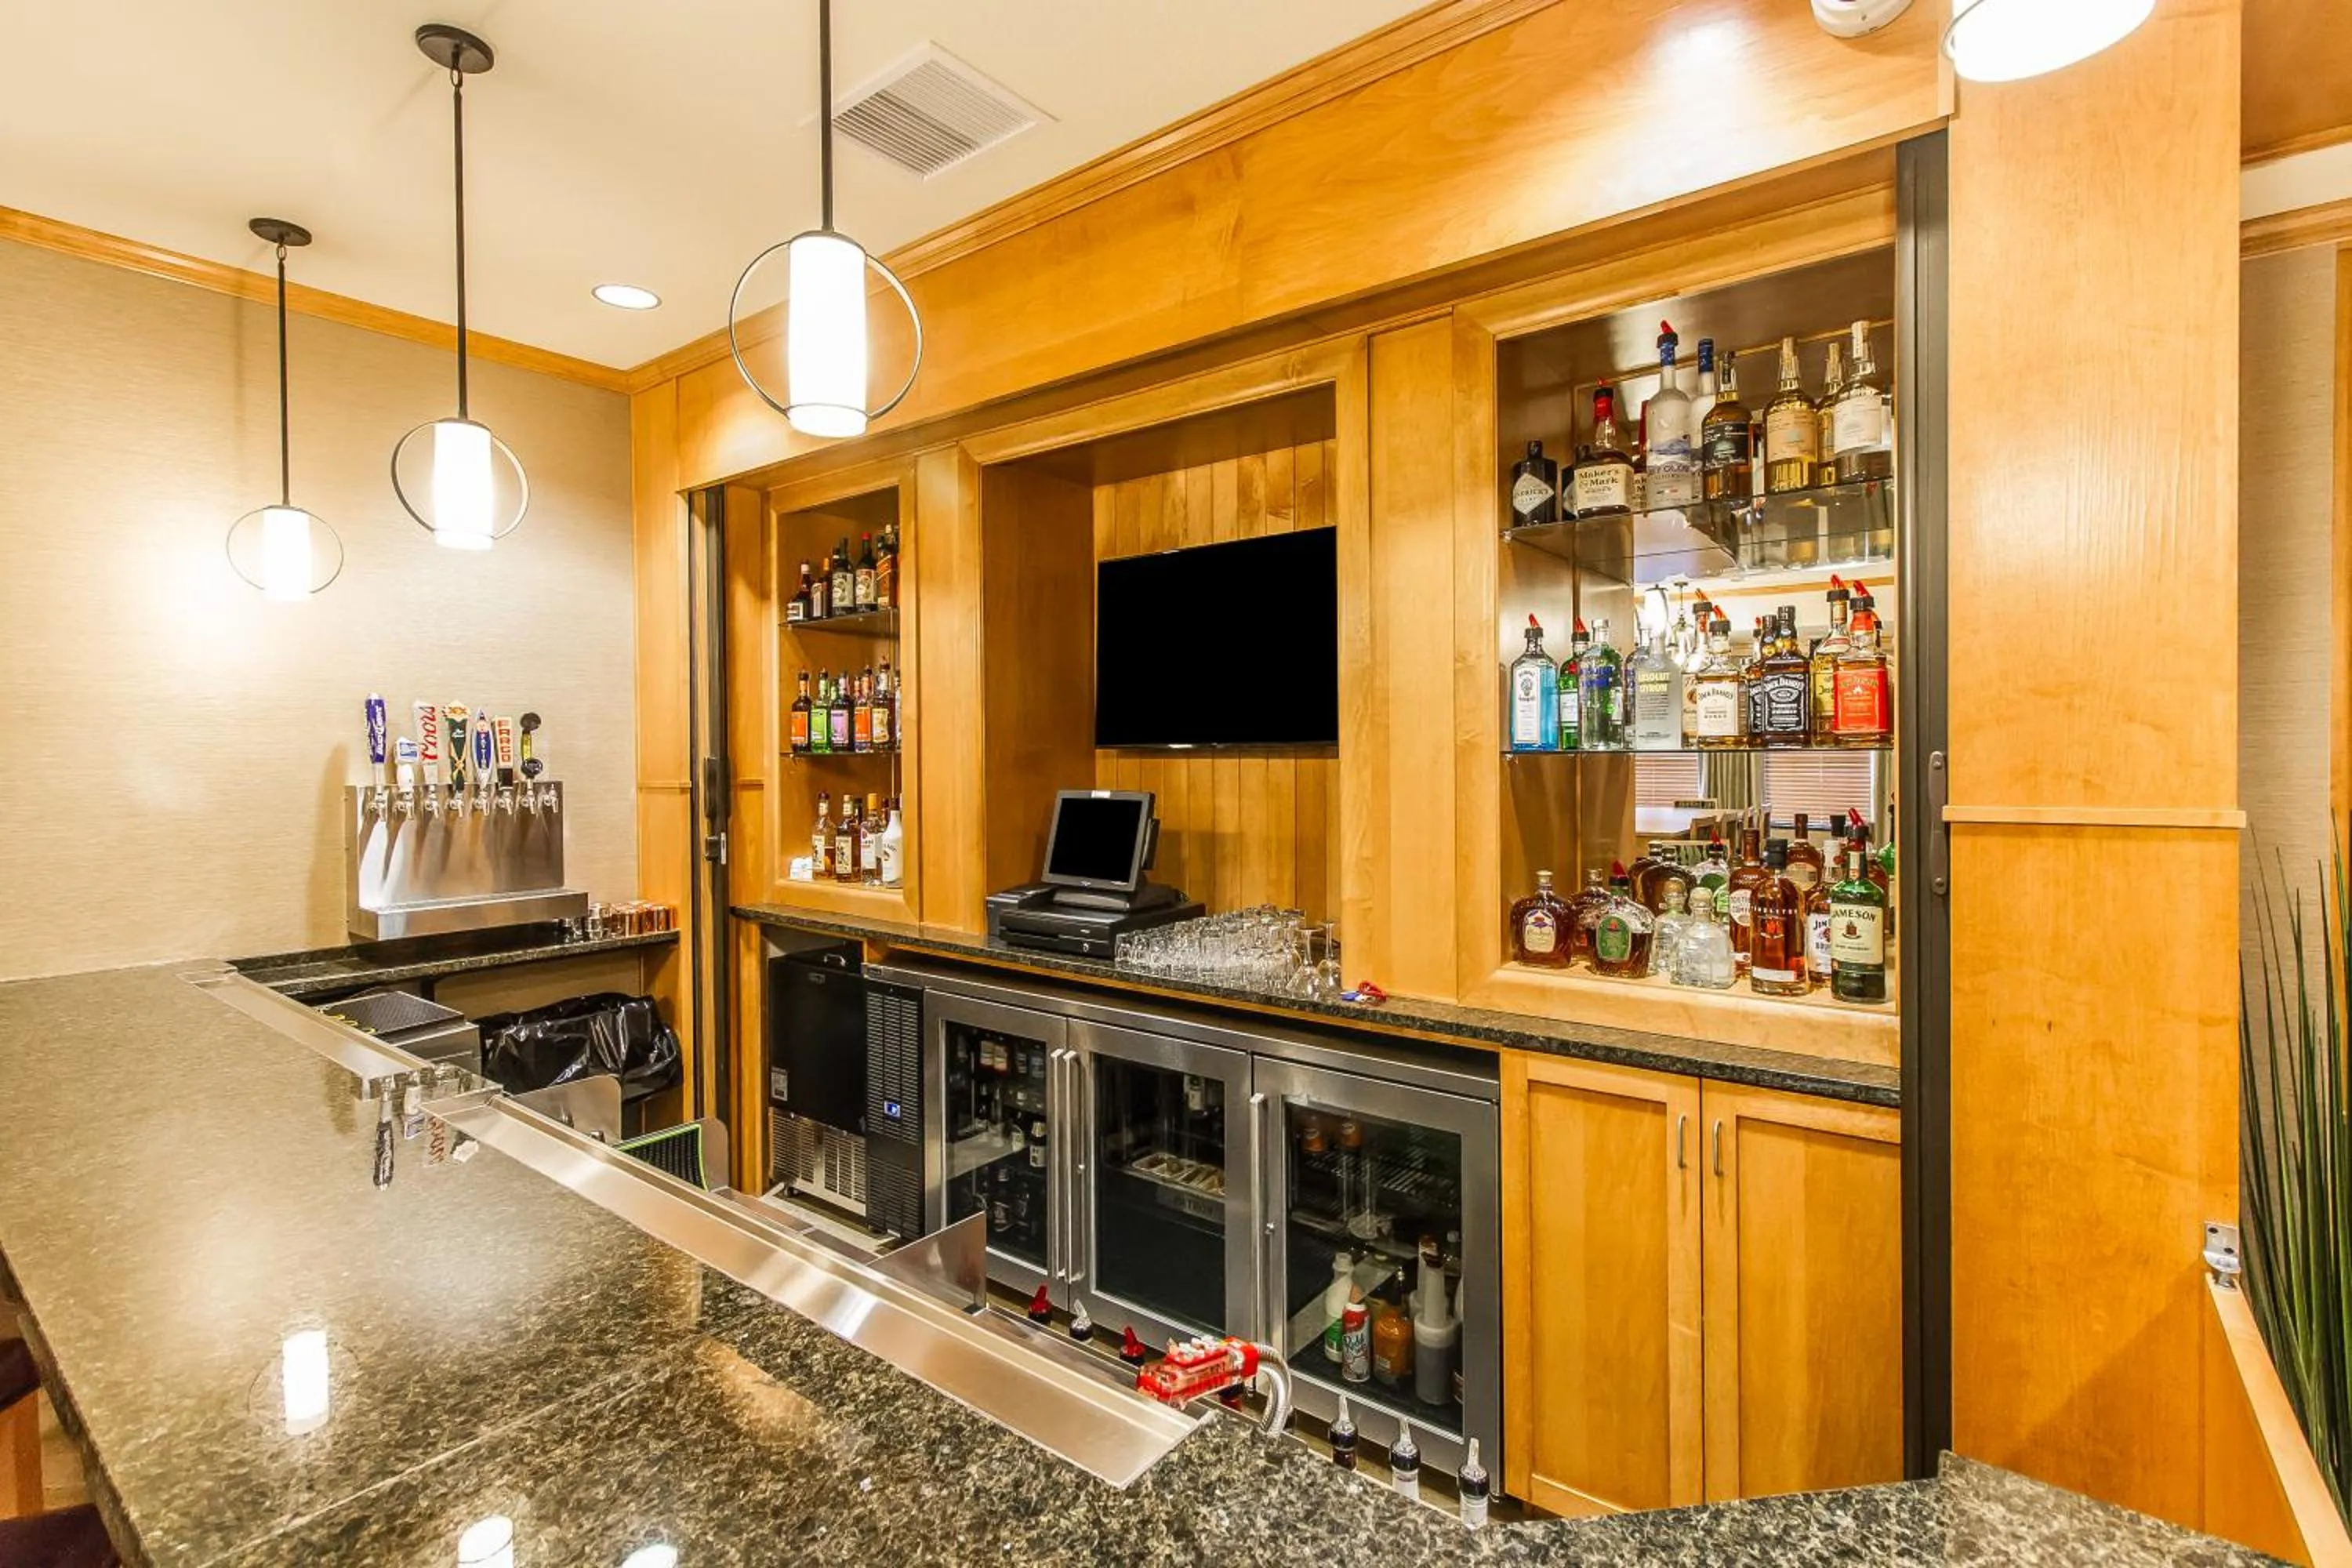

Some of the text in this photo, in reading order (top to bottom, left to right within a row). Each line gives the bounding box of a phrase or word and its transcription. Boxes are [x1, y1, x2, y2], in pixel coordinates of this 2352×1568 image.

[1578, 470, 1620, 481] Maker's
[1589, 476, 1619, 487] Mark
[1831, 908, 1877, 923] JAMESON
